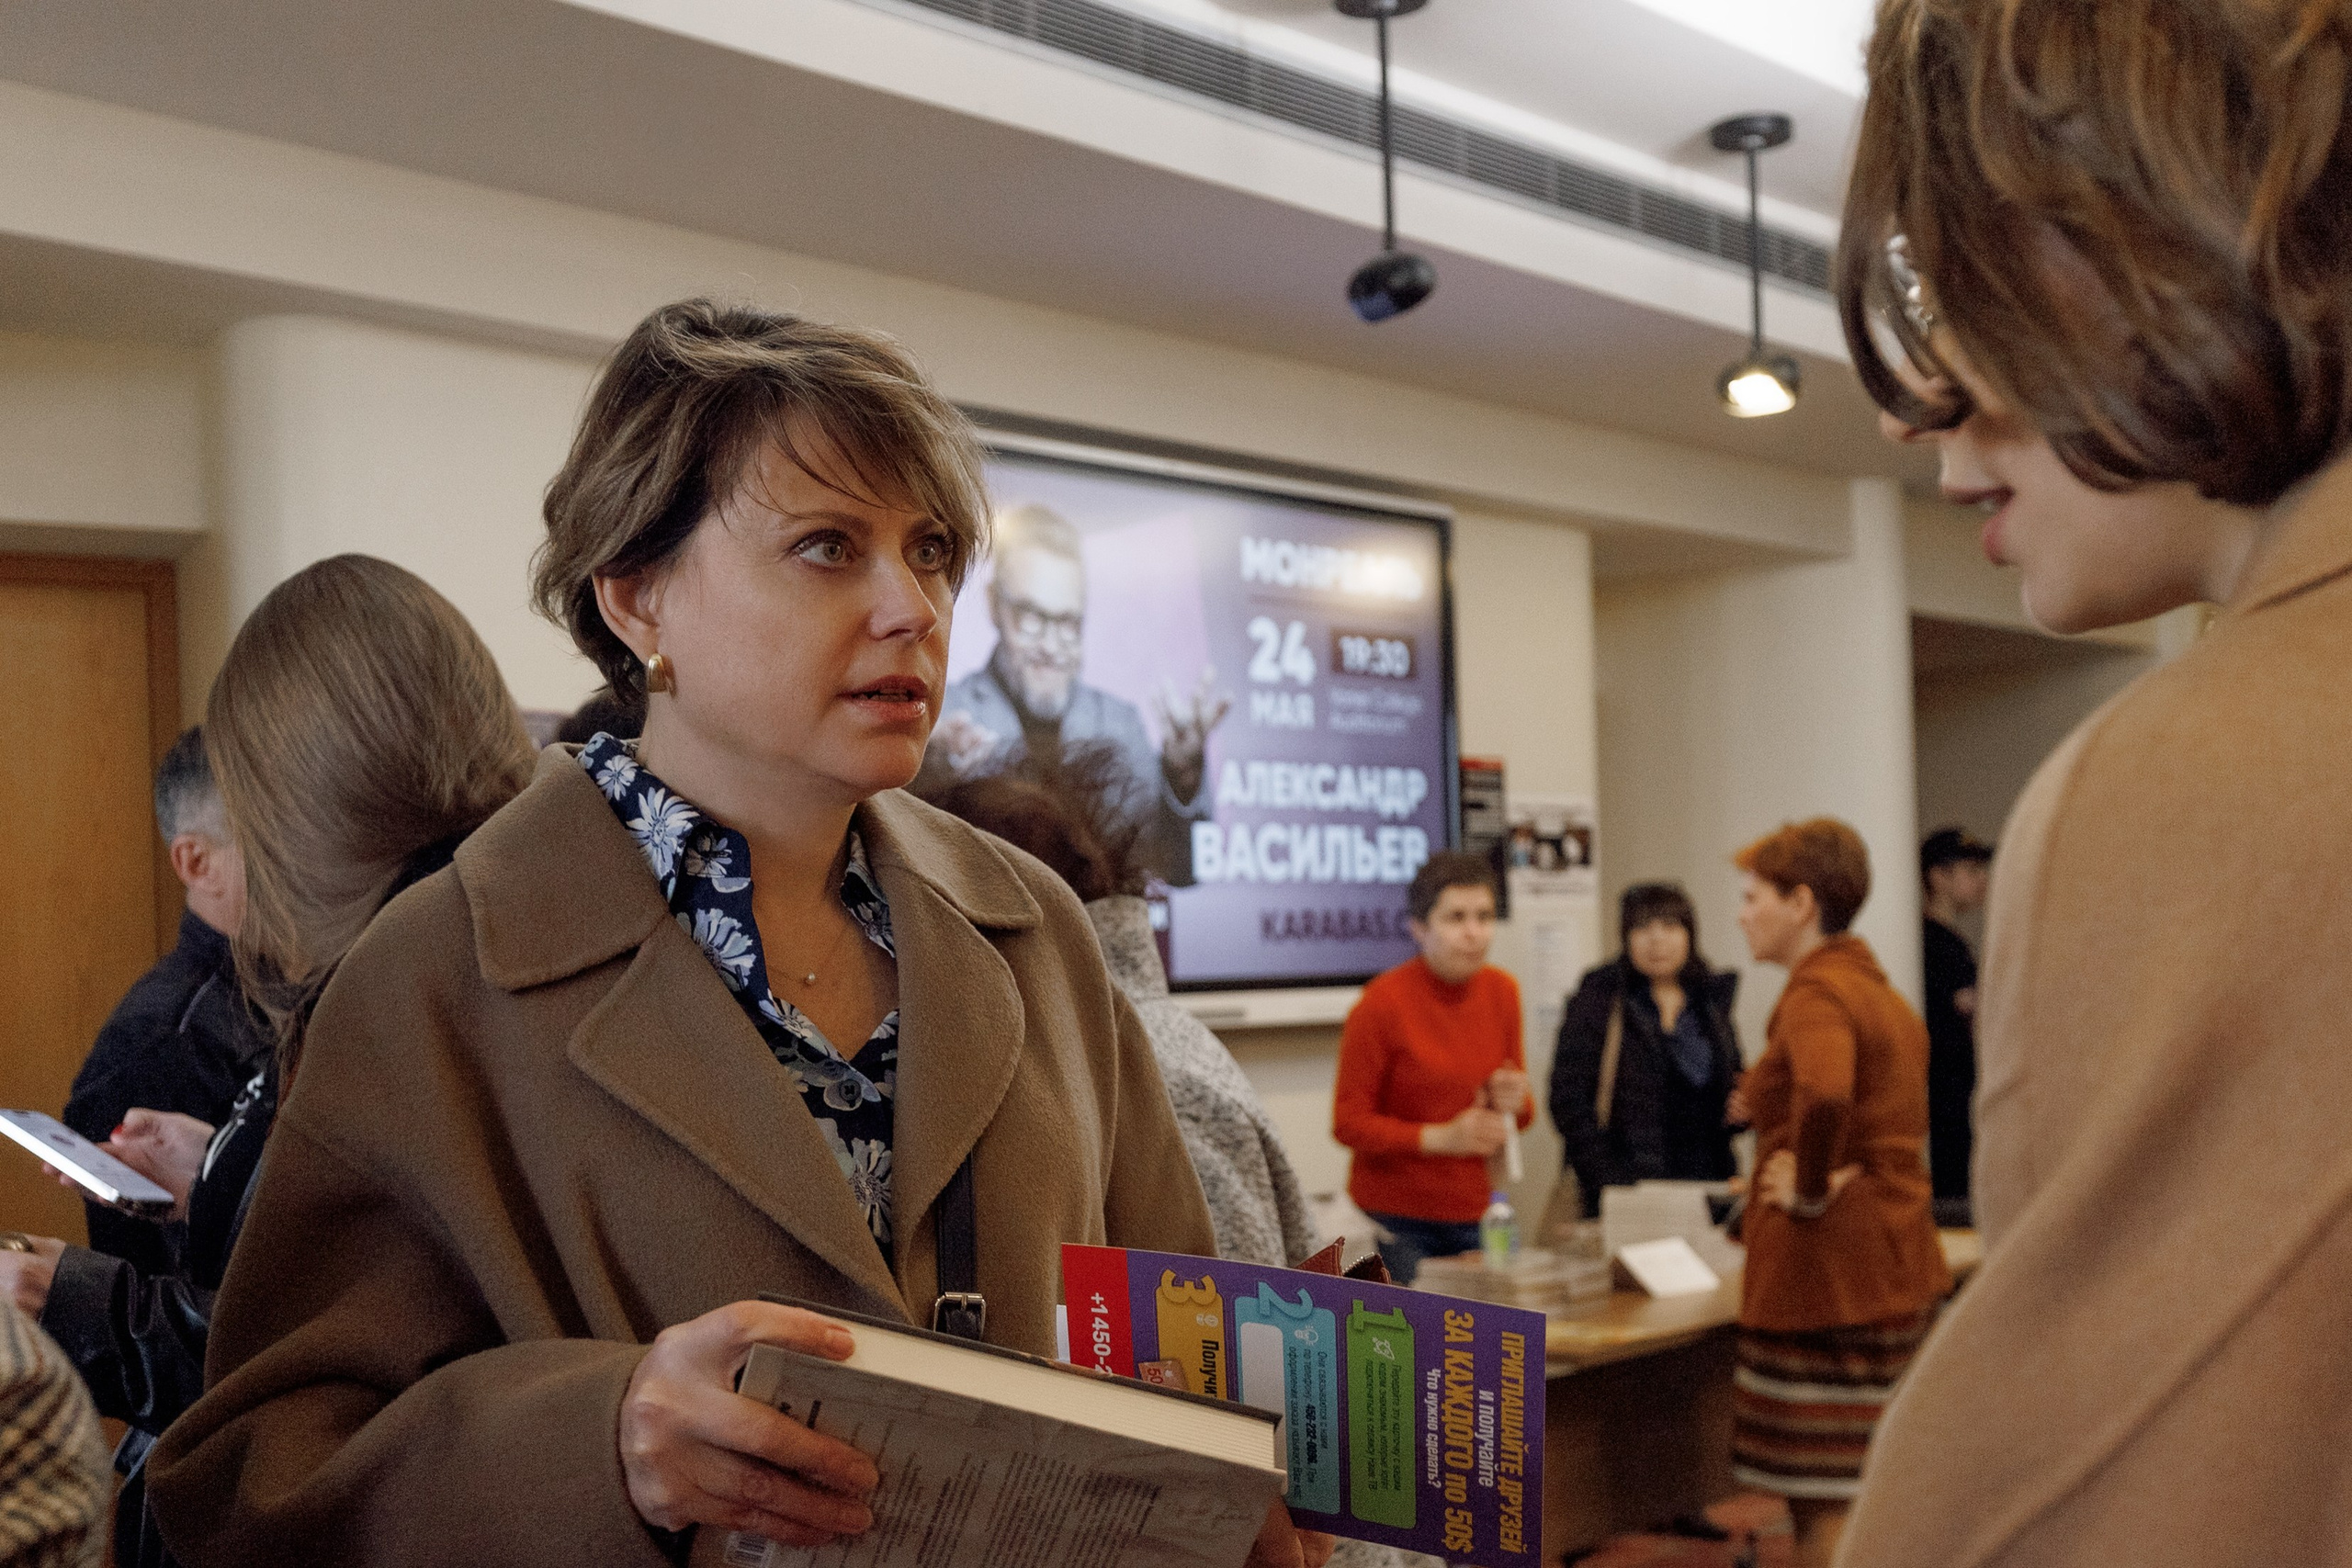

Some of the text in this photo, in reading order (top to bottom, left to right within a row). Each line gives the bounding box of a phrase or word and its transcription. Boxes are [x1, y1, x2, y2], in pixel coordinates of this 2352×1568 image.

[1240, 536, 1423, 600] МОНР
[1247, 616, 1317, 685] 24
[1339, 636, 1410, 677] 19:30
[1250, 692, 1316, 729] МАЯ
[1217, 760, 1428, 819] АЛЕКСАНДР
[1160, 1269, 1217, 1305] 3
[1257, 1280, 1314, 1319] 2
[1351, 1299, 1408, 1332] 1
[1148, 1368, 1164, 1385] 50
[1199, 1338, 1220, 1399] Получи
[1317, 1350, 1329, 1368] Они
[1391, 1364, 1402, 1406] Передайте
[1391, 1422, 1401, 1456] карточку
[1424, 1368, 1442, 1489] Что нужно сделать?
[1441, 1309, 1475, 1553] ЗА КАЖДОГО по 50$
[1474, 1389, 1500, 1487] и получайте
[1497, 1330, 1530, 1554] ПРИГЛАШАЙТЕ ДРУЗЕЙ
